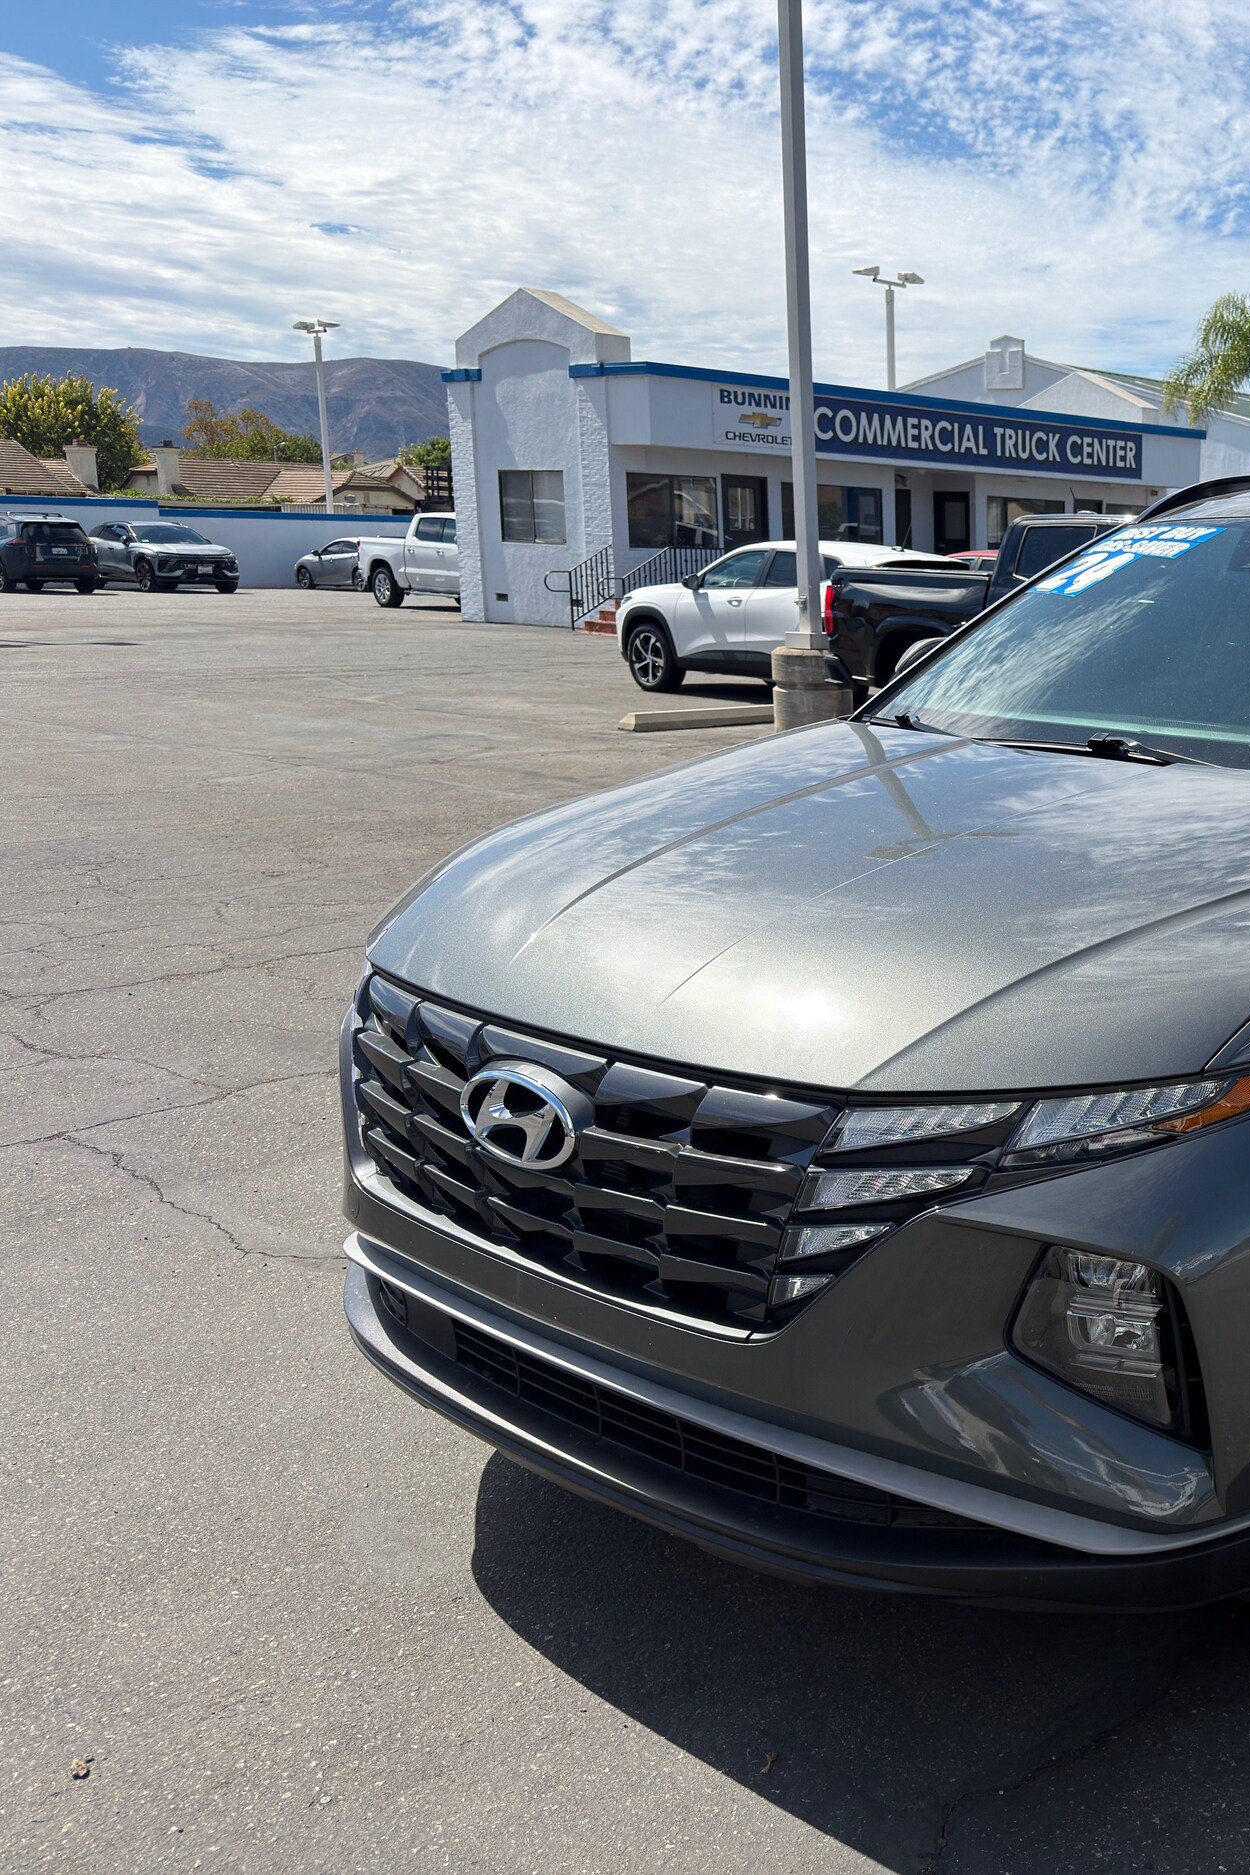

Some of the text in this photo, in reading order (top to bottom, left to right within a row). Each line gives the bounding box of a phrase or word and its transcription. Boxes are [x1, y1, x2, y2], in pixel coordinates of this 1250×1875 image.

[813, 405, 1136, 469] COMMERCIAL TRUCK CENTER
[1111, 526, 1217, 541] BEST BUY
